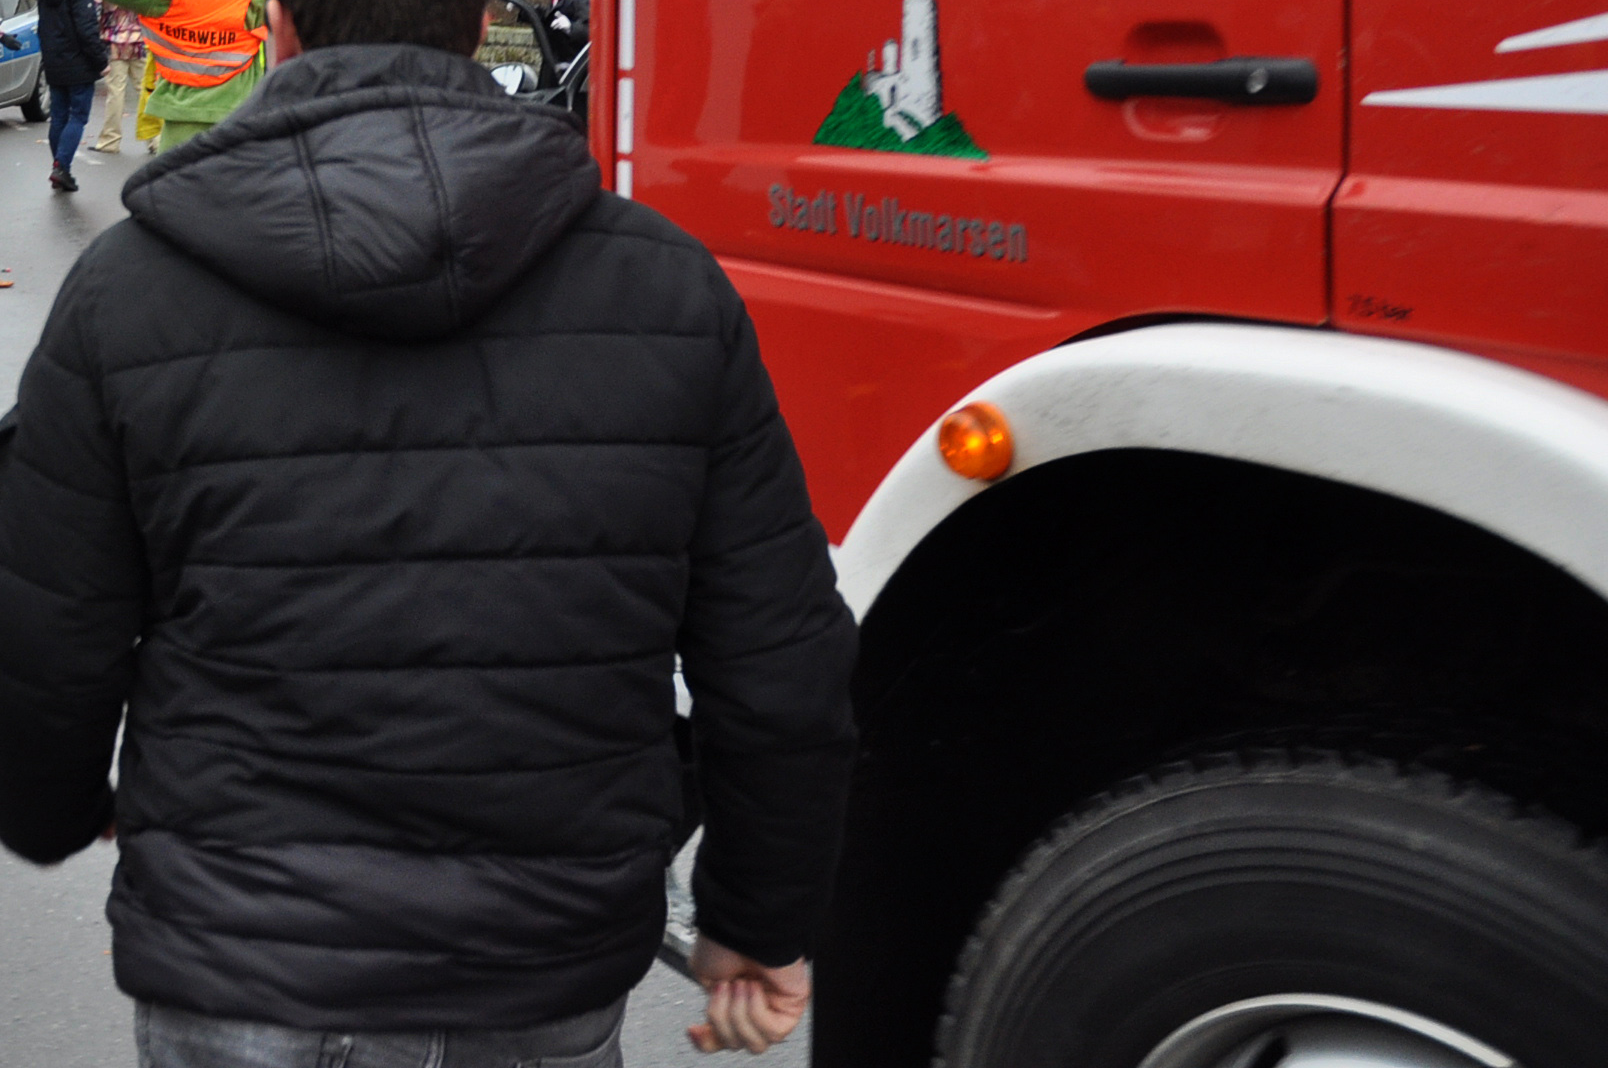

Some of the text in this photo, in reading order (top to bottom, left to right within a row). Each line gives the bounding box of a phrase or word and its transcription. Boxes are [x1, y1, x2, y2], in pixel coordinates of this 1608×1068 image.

[159, 22, 236, 46] FEUERWEHR
[769, 184, 1028, 263] Stadt Volkmarsen
